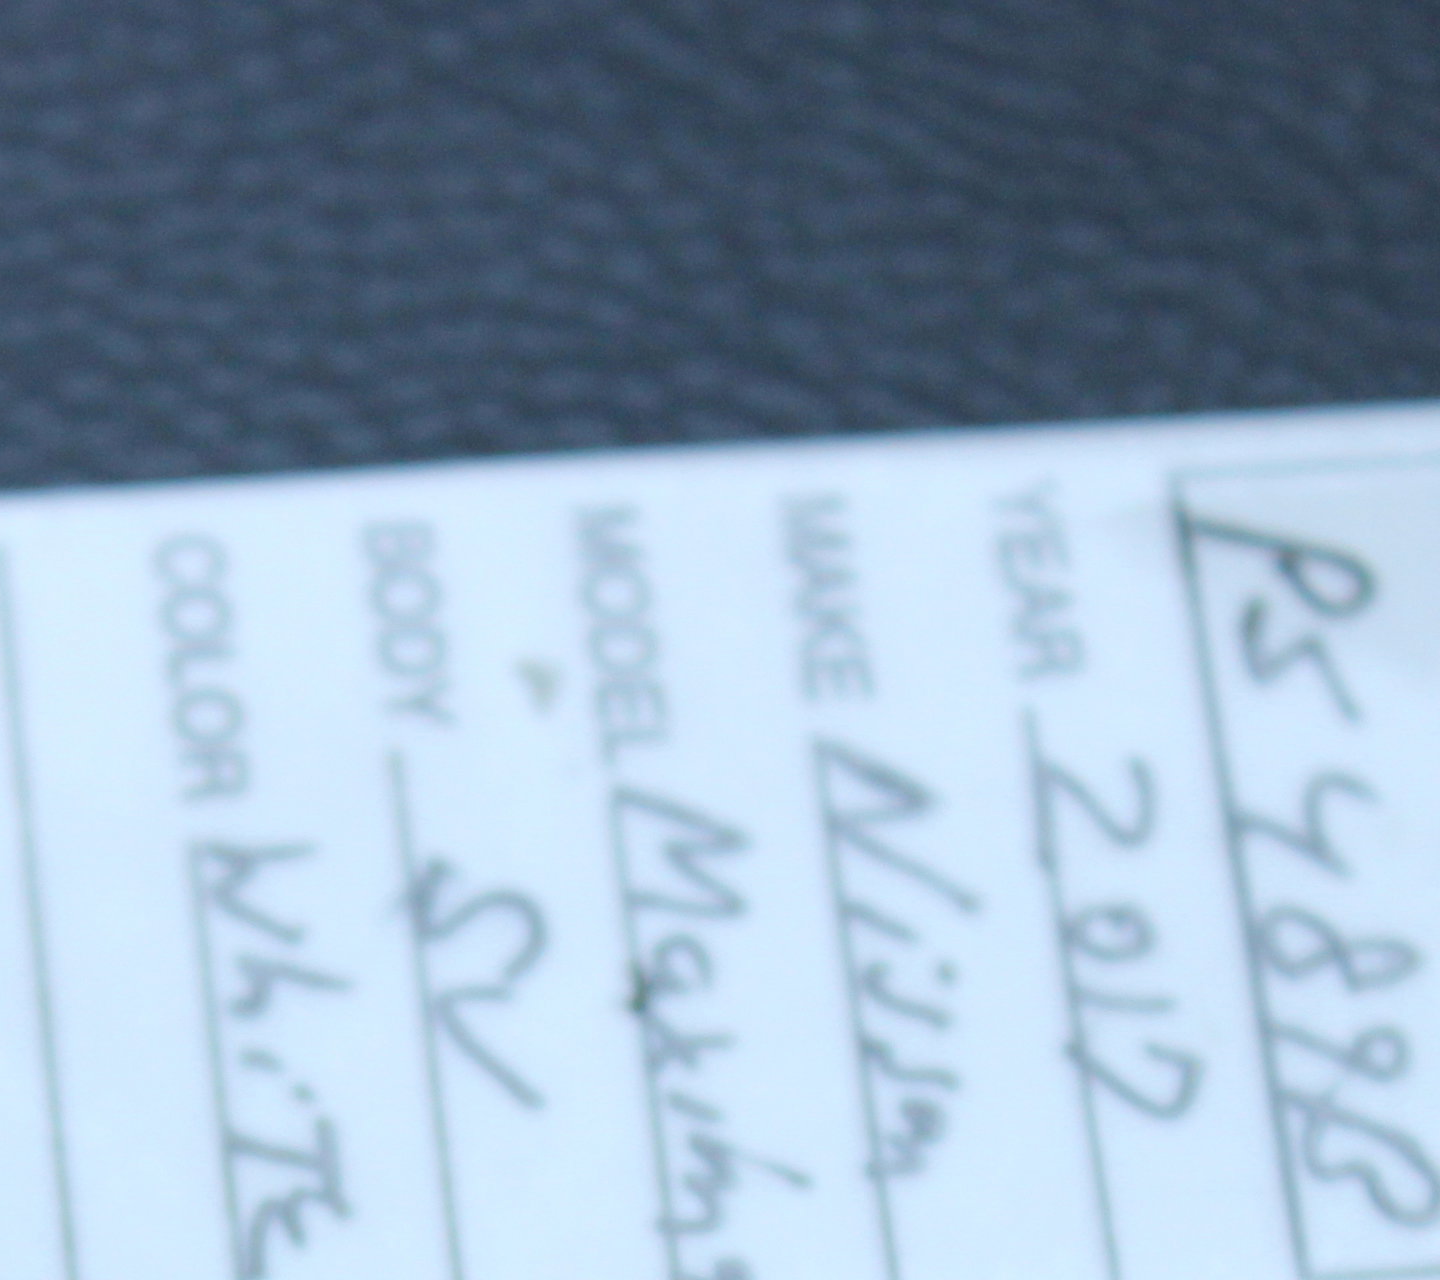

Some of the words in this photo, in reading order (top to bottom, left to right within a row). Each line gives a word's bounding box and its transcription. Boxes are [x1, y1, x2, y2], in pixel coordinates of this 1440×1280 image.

[152, 532, 252, 803] COLOR
[363, 519, 456, 730] BODY
[571, 504, 670, 765] MODEL
[779, 490, 874, 703] MAKE
[993, 476, 1086, 681] YEAR
[1035, 756, 1204, 1120] 2017
